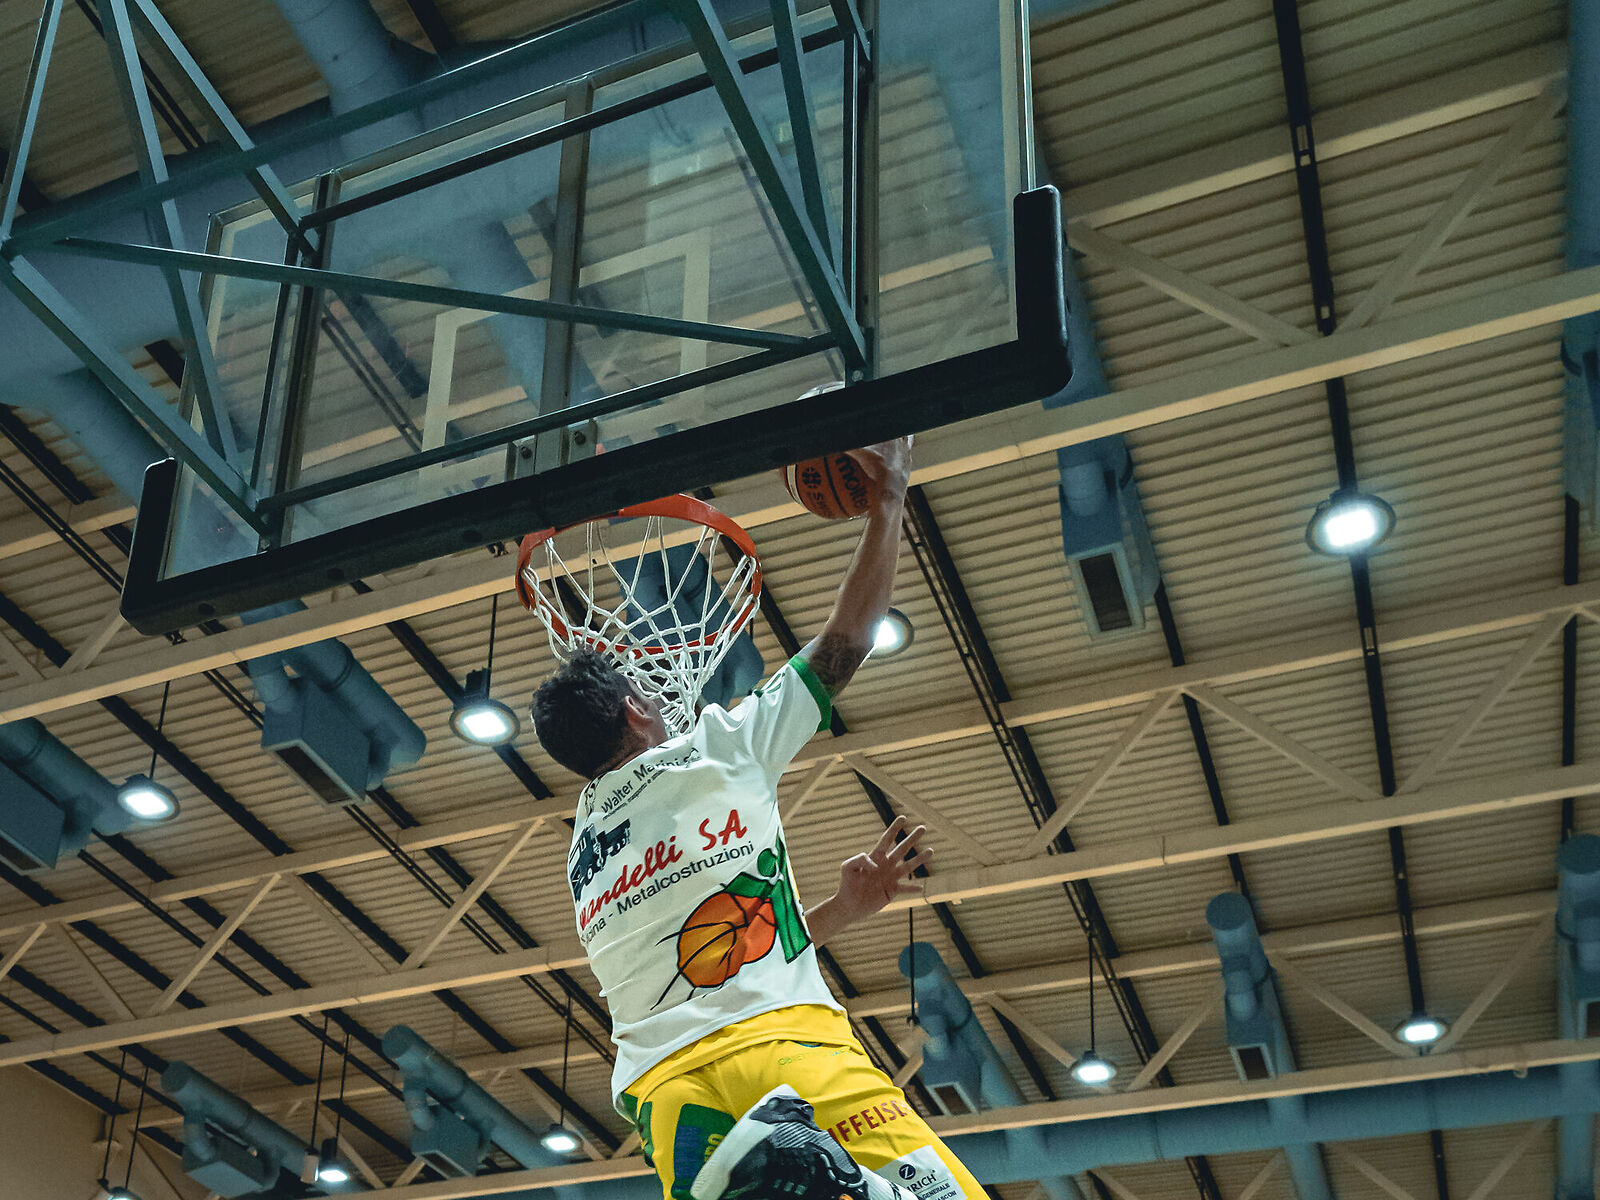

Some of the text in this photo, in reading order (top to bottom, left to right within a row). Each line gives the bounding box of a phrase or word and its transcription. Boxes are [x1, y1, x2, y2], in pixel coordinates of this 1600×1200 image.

[601, 780, 634, 813] Walter
[698, 809, 748, 851] SA
[583, 916, 607, 943] cina
[616, 841, 754, 915] Metalcostruzioni
